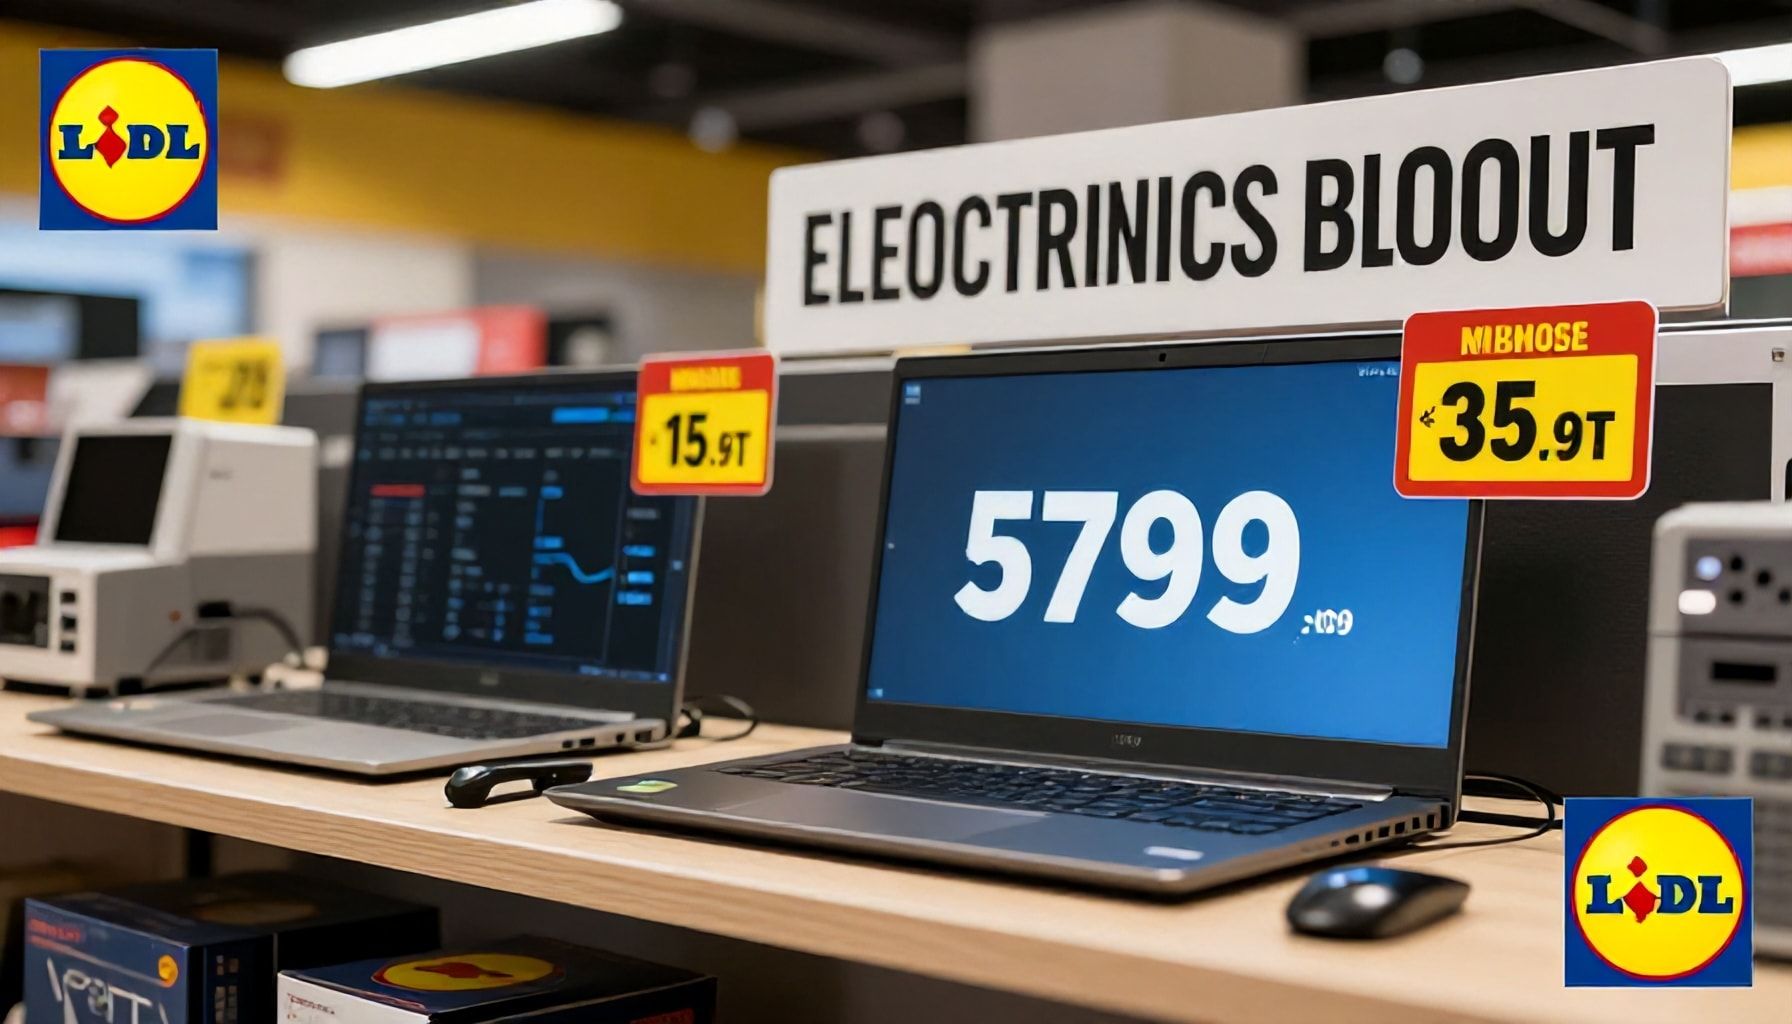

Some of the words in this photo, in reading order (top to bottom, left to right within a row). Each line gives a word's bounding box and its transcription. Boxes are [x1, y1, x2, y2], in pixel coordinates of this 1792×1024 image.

[803, 162, 1279, 307] ELEOCTRINICS
[1303, 123, 1655, 274] BLOOUT
[953, 489, 1300, 634] 5799
